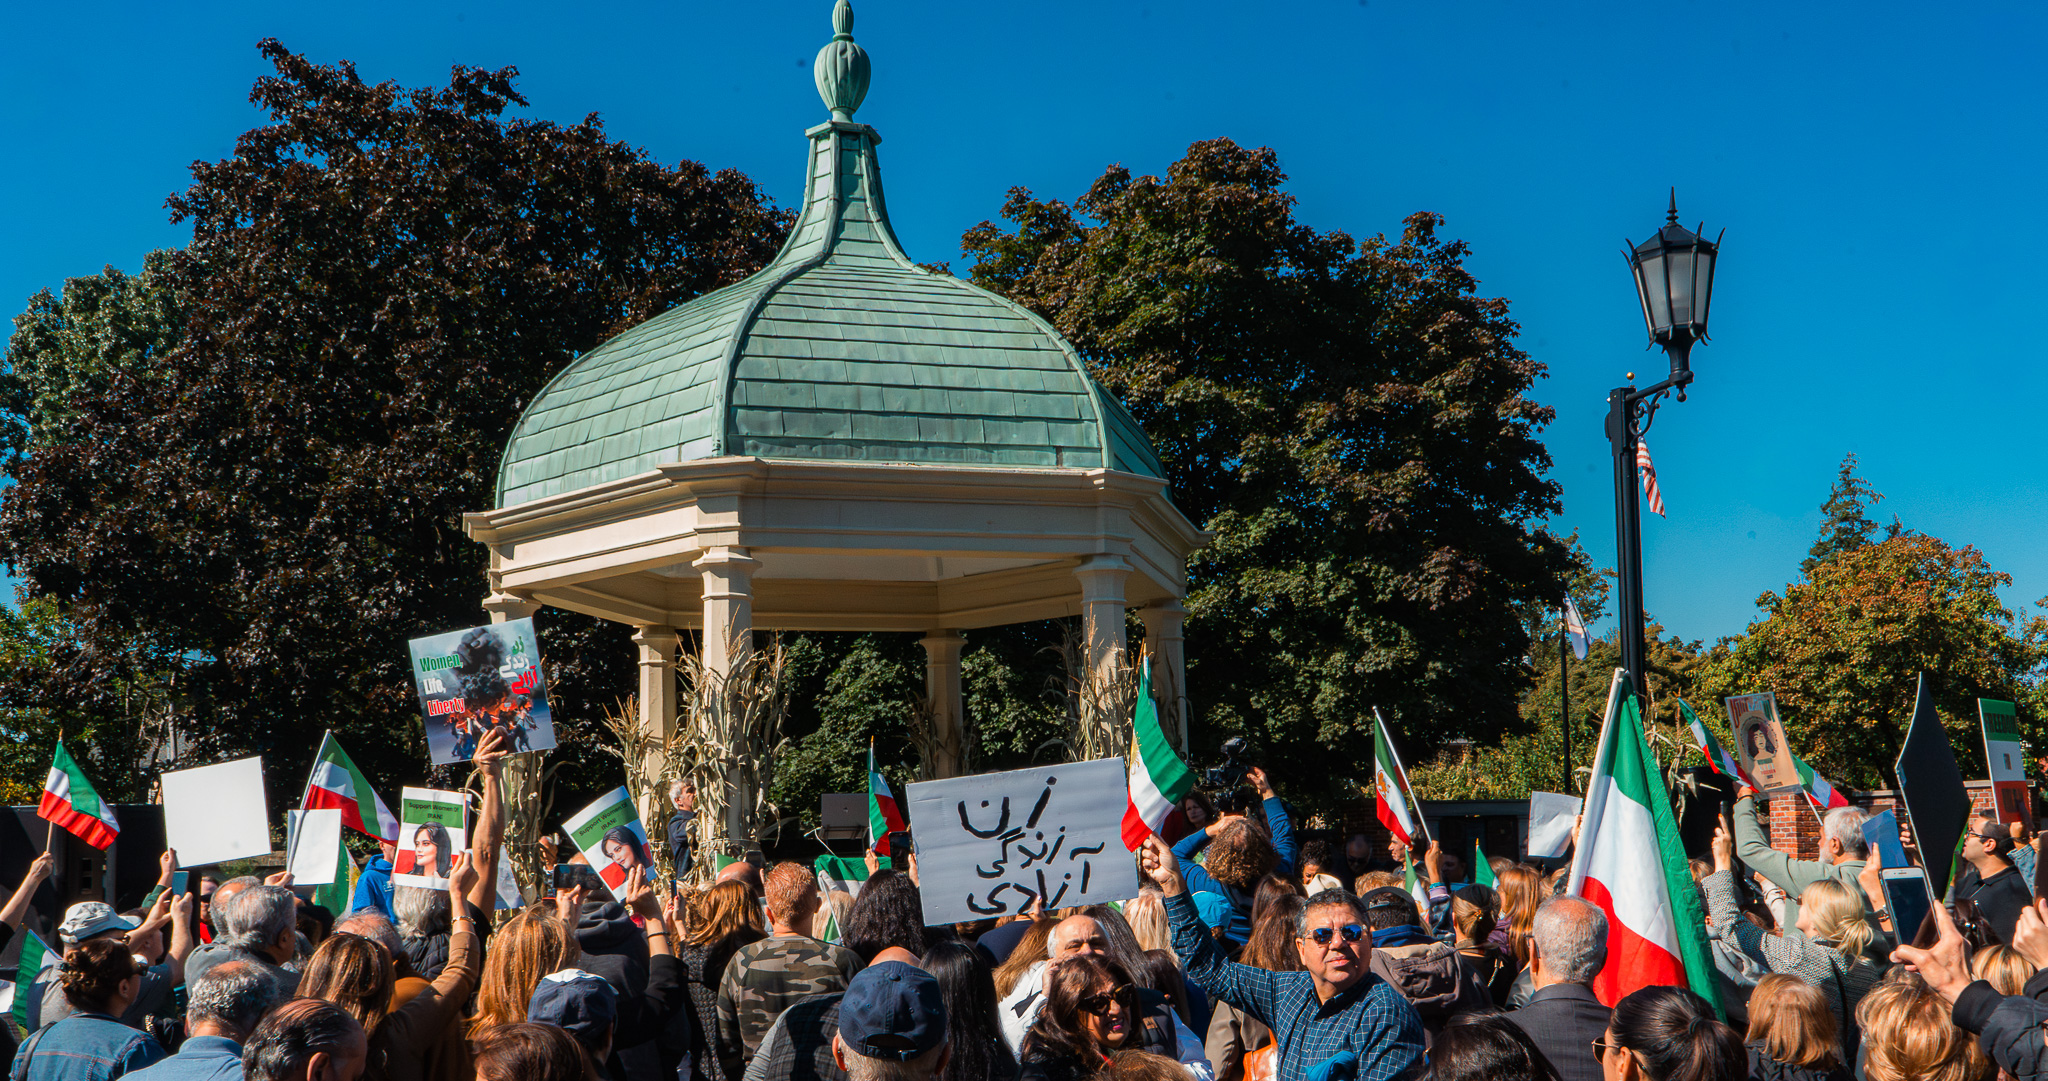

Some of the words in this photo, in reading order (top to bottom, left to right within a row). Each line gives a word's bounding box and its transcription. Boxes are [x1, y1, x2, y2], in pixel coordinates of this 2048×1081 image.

[419, 654, 464, 673] Women,
[423, 677, 447, 695] Life,
[427, 697, 466, 717] Liberty
[408, 802, 432, 810] Support
[958, 776, 1057, 839] زن
[579, 818, 602, 836] Support
[601, 806, 622, 819] Women
[976, 825, 1066, 879] زندگی
[966, 841, 1105, 915] آزادی
